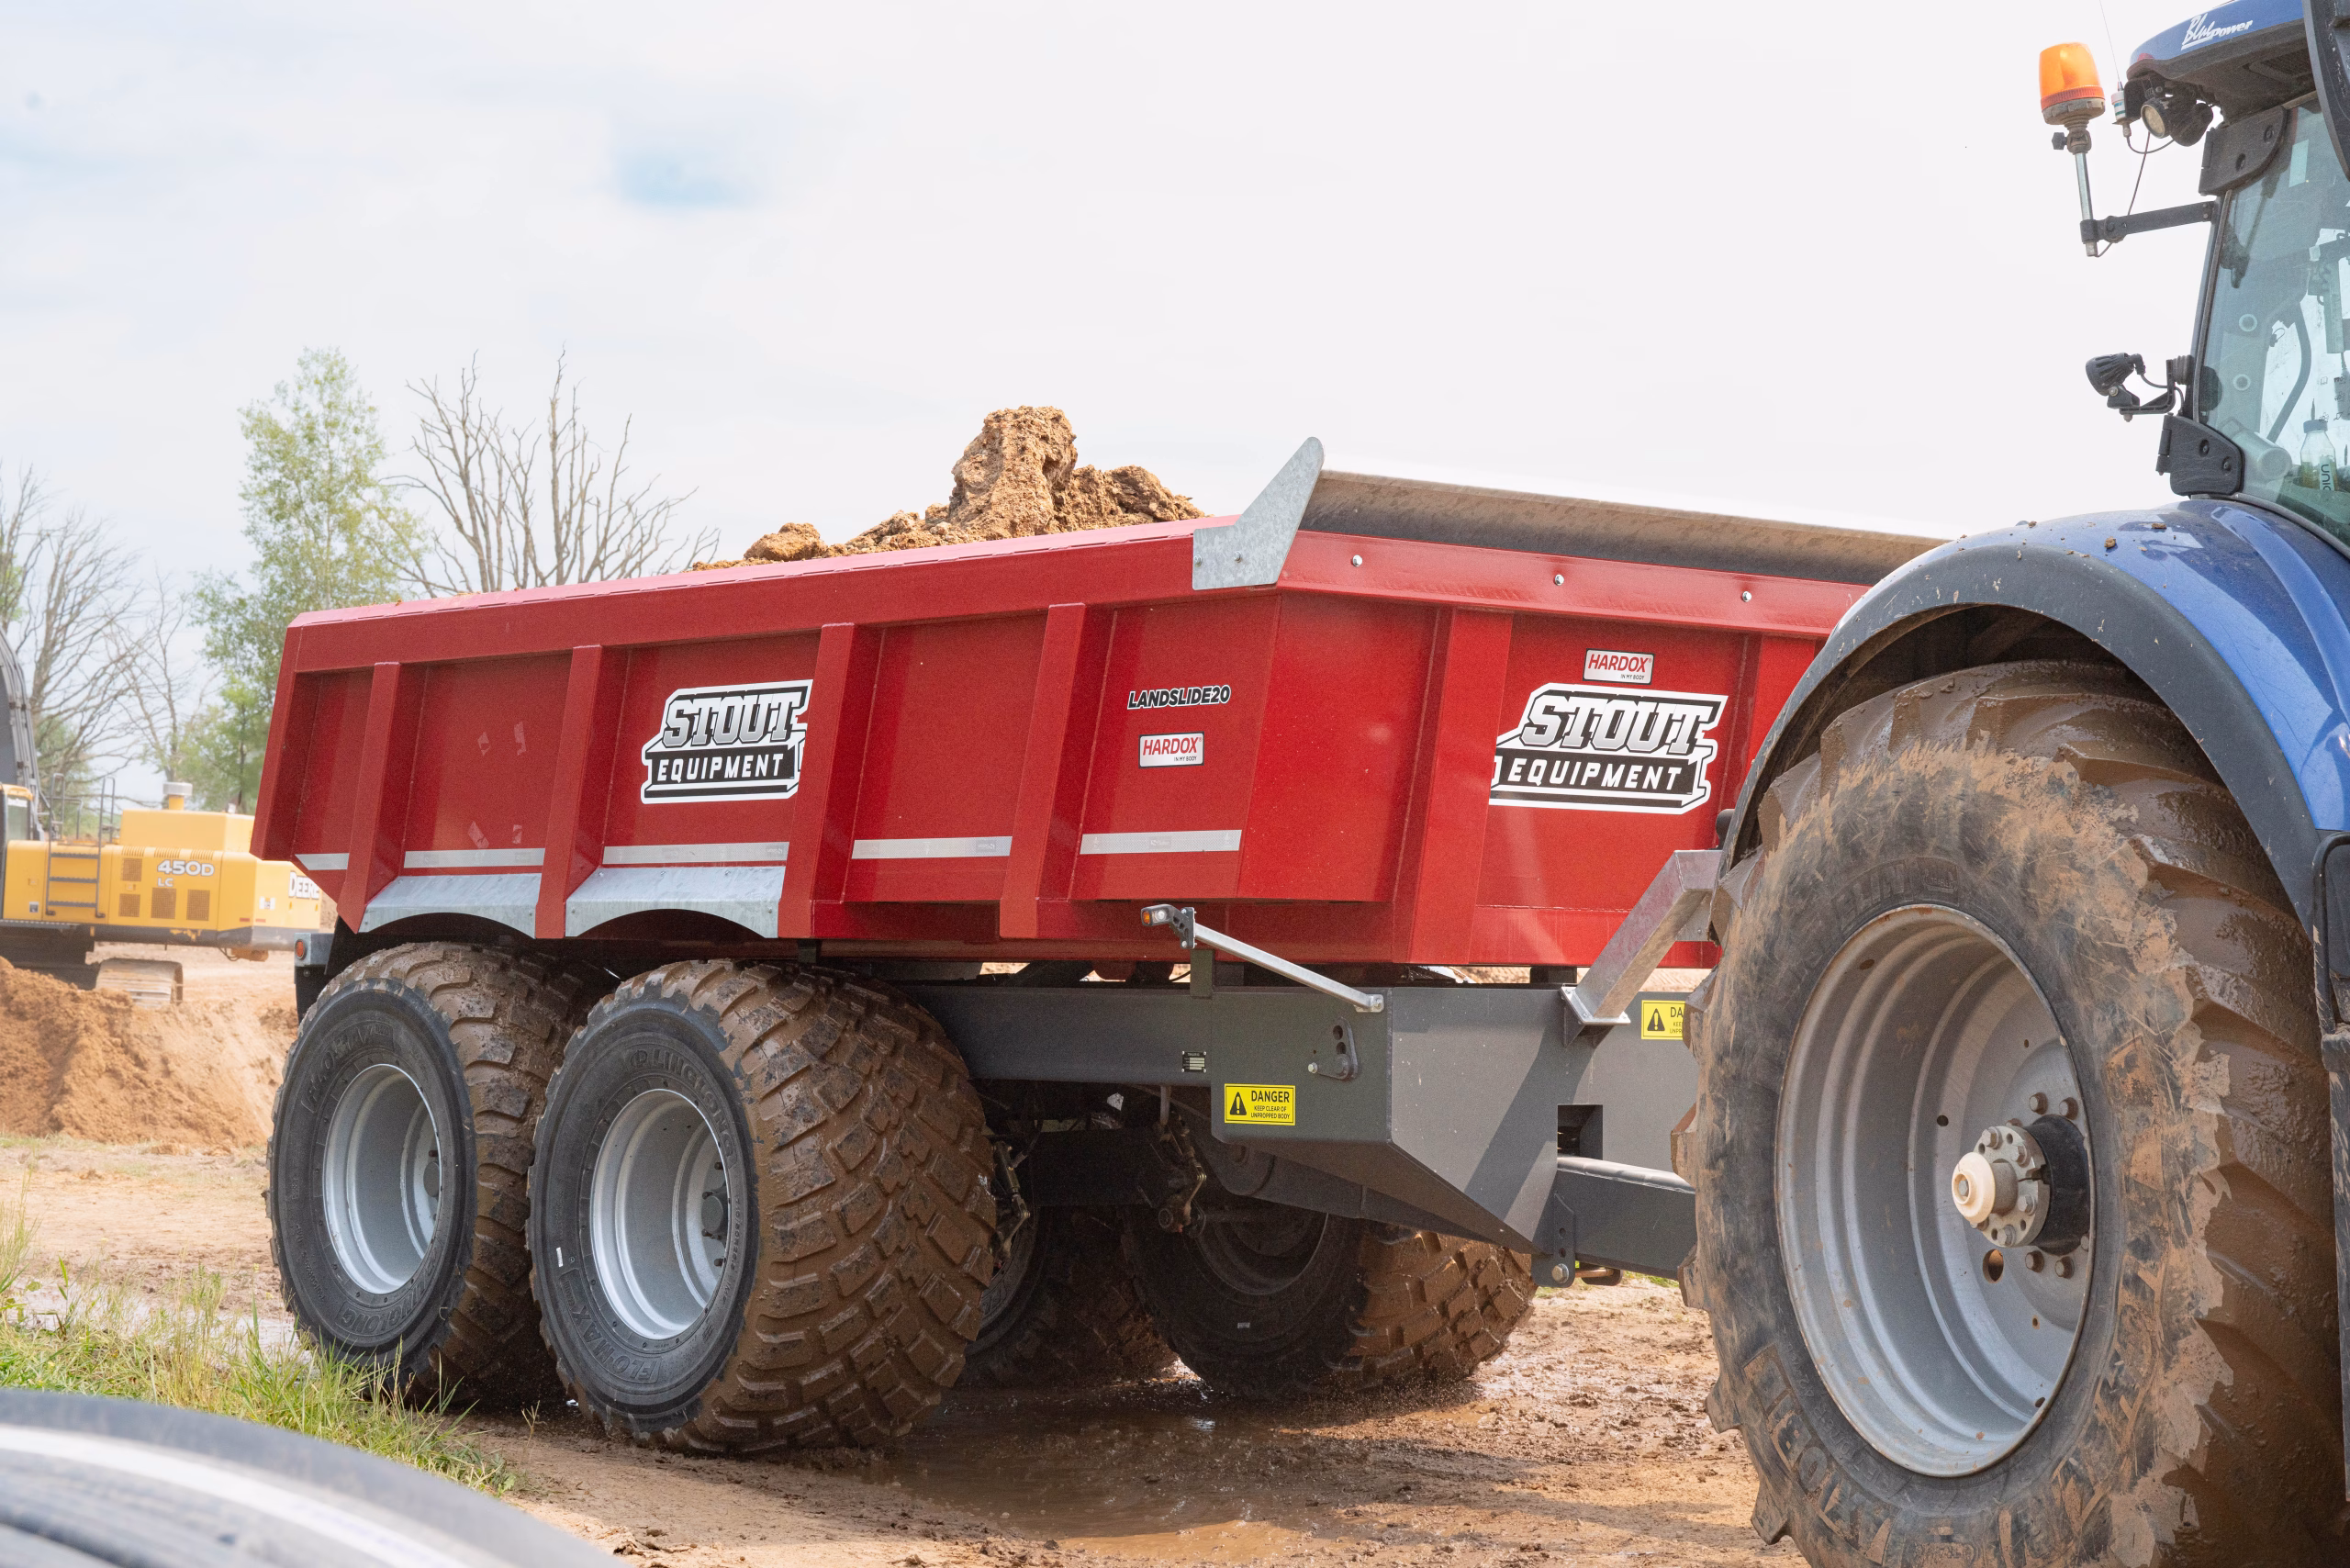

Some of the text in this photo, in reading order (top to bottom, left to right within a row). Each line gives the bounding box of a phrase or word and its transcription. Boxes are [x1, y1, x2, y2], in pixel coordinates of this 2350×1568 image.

[1127, 684, 1232, 710] LANDSLIDE20
[662, 690, 802, 748] STOUT
[1519, 694, 1711, 756] STOUT
[656, 753, 784, 784] EQUIPMENT
[1507, 757, 1683, 790] EQUIPMENT
[157, 858, 216, 877] 450D
[157, 878, 174, 889] LC
[1251, 1091, 1290, 1103] DANGER
